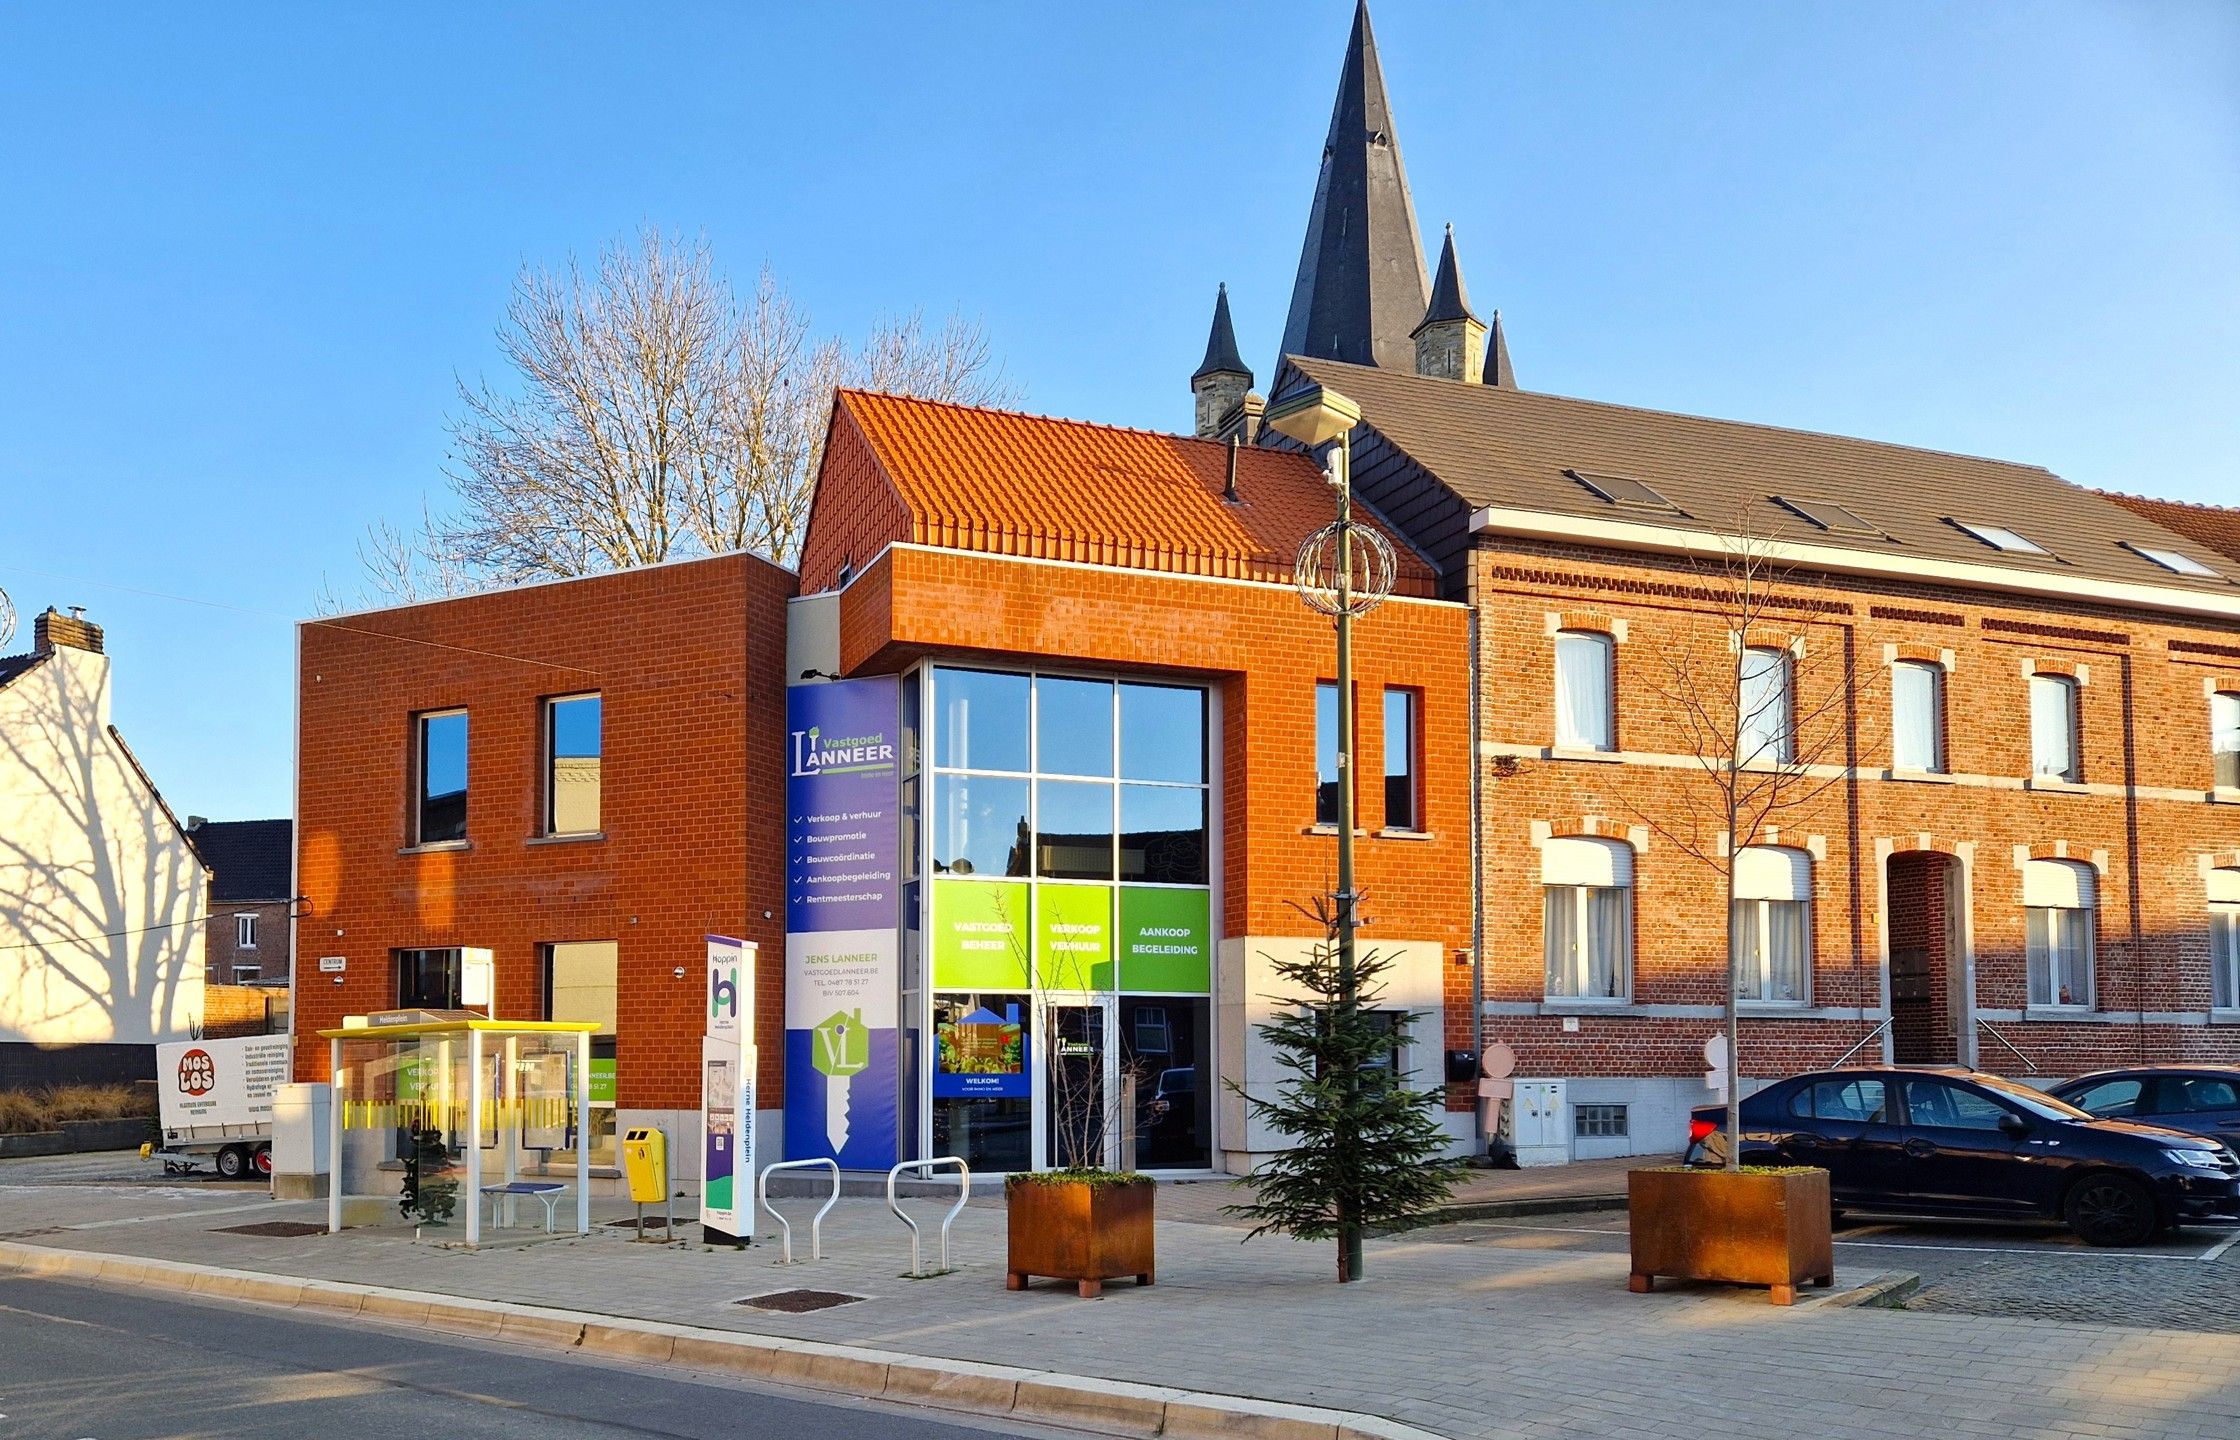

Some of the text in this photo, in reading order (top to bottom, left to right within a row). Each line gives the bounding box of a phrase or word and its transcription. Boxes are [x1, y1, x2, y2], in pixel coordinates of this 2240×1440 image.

[823, 732, 883, 749] Vastgoed
[807, 811, 882, 824] Verkoop & verhuur
[806, 831, 867, 843] Bouwpromotie
[806, 851, 876, 864] Bouwcoördinatie
[806, 871, 891, 884] Aankoopbegeleiding
[806, 892, 883, 904] Rentmeesterschap
[1050, 924, 1101, 934] VERKOOP
[1139, 927, 1191, 937] AANKOOP
[961, 940, 1005, 950] BEHEER
[1050, 941, 1101, 951] VERHUUR
[1132, 944, 1198, 955] BEGELEIDING
[713, 953, 738, 966] Hoppin
[805, 953, 878, 964] JENS LANNEER
[804, 967, 879, 976] VASTGOEDLANNEER.BE
[379, 1014, 408, 1024] Heldenplein
[182, 1056, 210, 1071] MOS
[179, 1070, 214, 1092] LOS
[744, 1108, 752, 1164] Heldenplein
